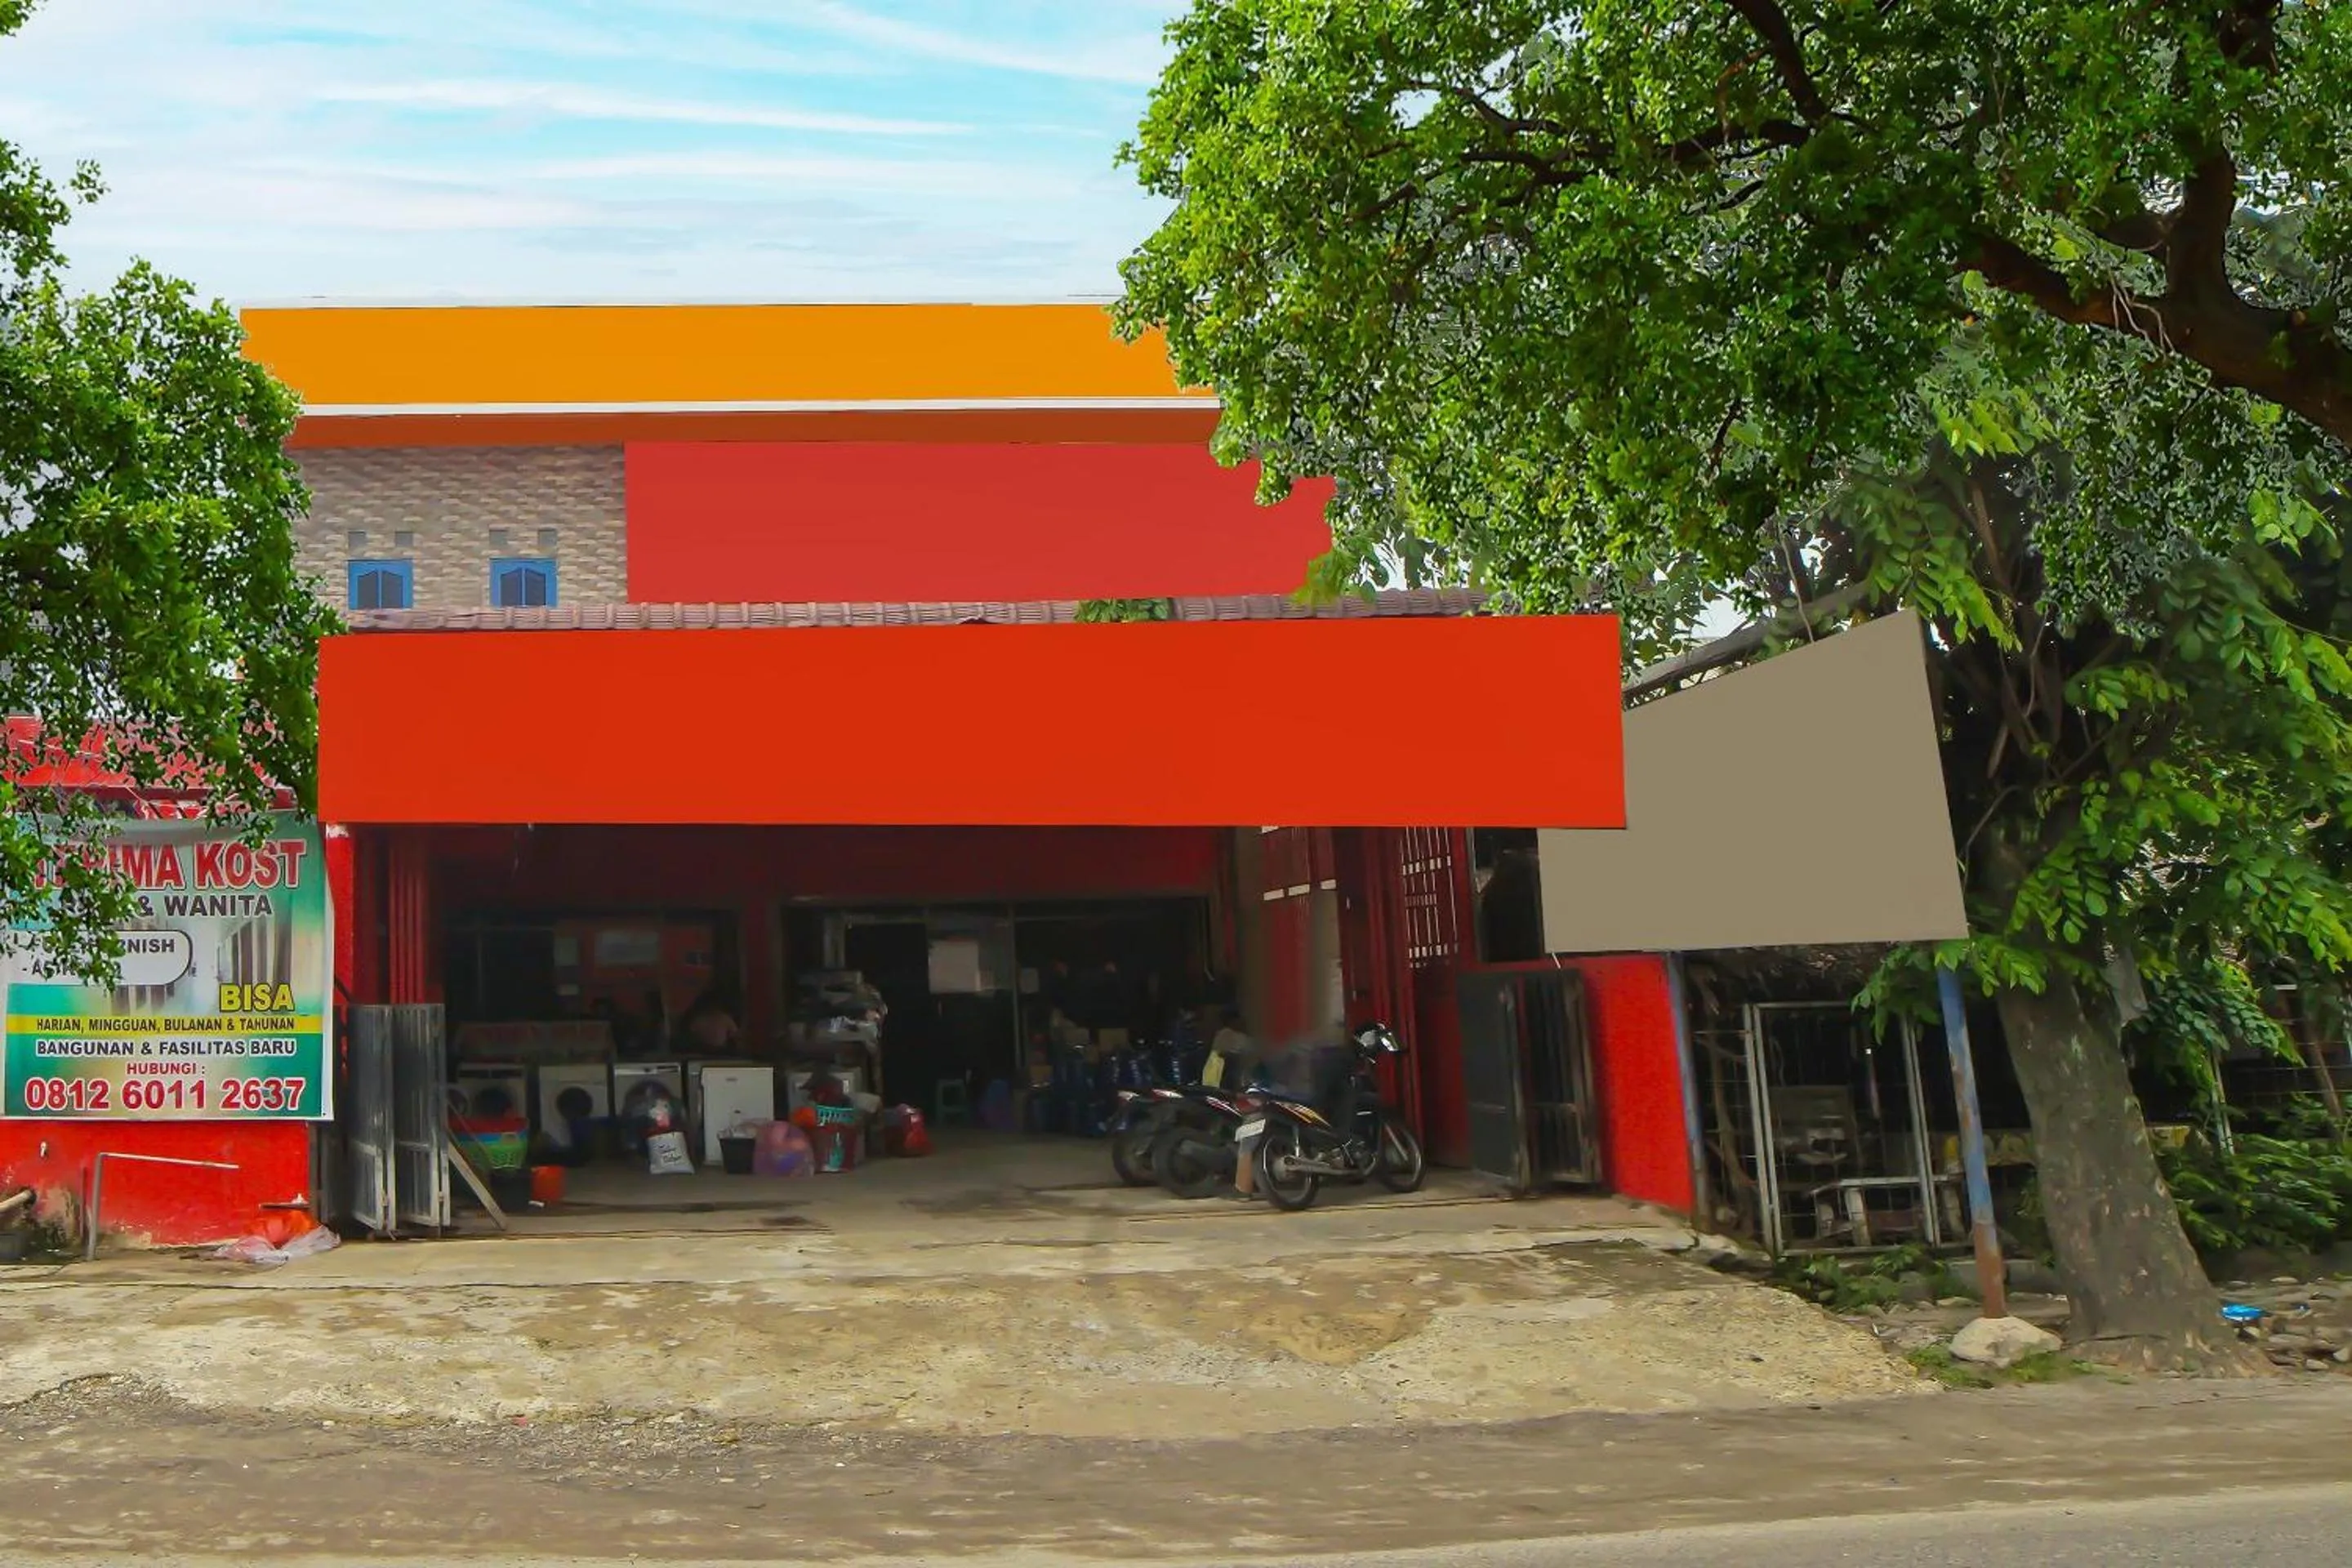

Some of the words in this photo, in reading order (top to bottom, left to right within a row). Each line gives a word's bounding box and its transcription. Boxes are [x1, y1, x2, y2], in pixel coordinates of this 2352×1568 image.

[195, 841, 305, 888] KOST
[138, 895, 154, 916] &
[164, 894, 273, 916] WANITA
[98, 938, 175, 954] NISH
[219, 983, 295, 1012] BISA
[37, 1018, 84, 1033] HARIAN,
[88, 1018, 161, 1033] MINGGUAN,
[164, 1018, 222, 1031] BULANAN
[226, 1018, 235, 1031] &
[240, 1018, 295, 1031] TAHUNAN
[38, 1040, 134, 1055] BANGUNAN
[140, 1041, 153, 1055] &
[159, 1040, 245, 1055] FASILITAS
[250, 1040, 295, 1055] BARU
[127, 1062, 196, 1075] HUBUNGI
[25, 1079, 109, 1110] 0812
[122, 1079, 204, 1110] 6011
[220, 1079, 304, 1110] 2637
